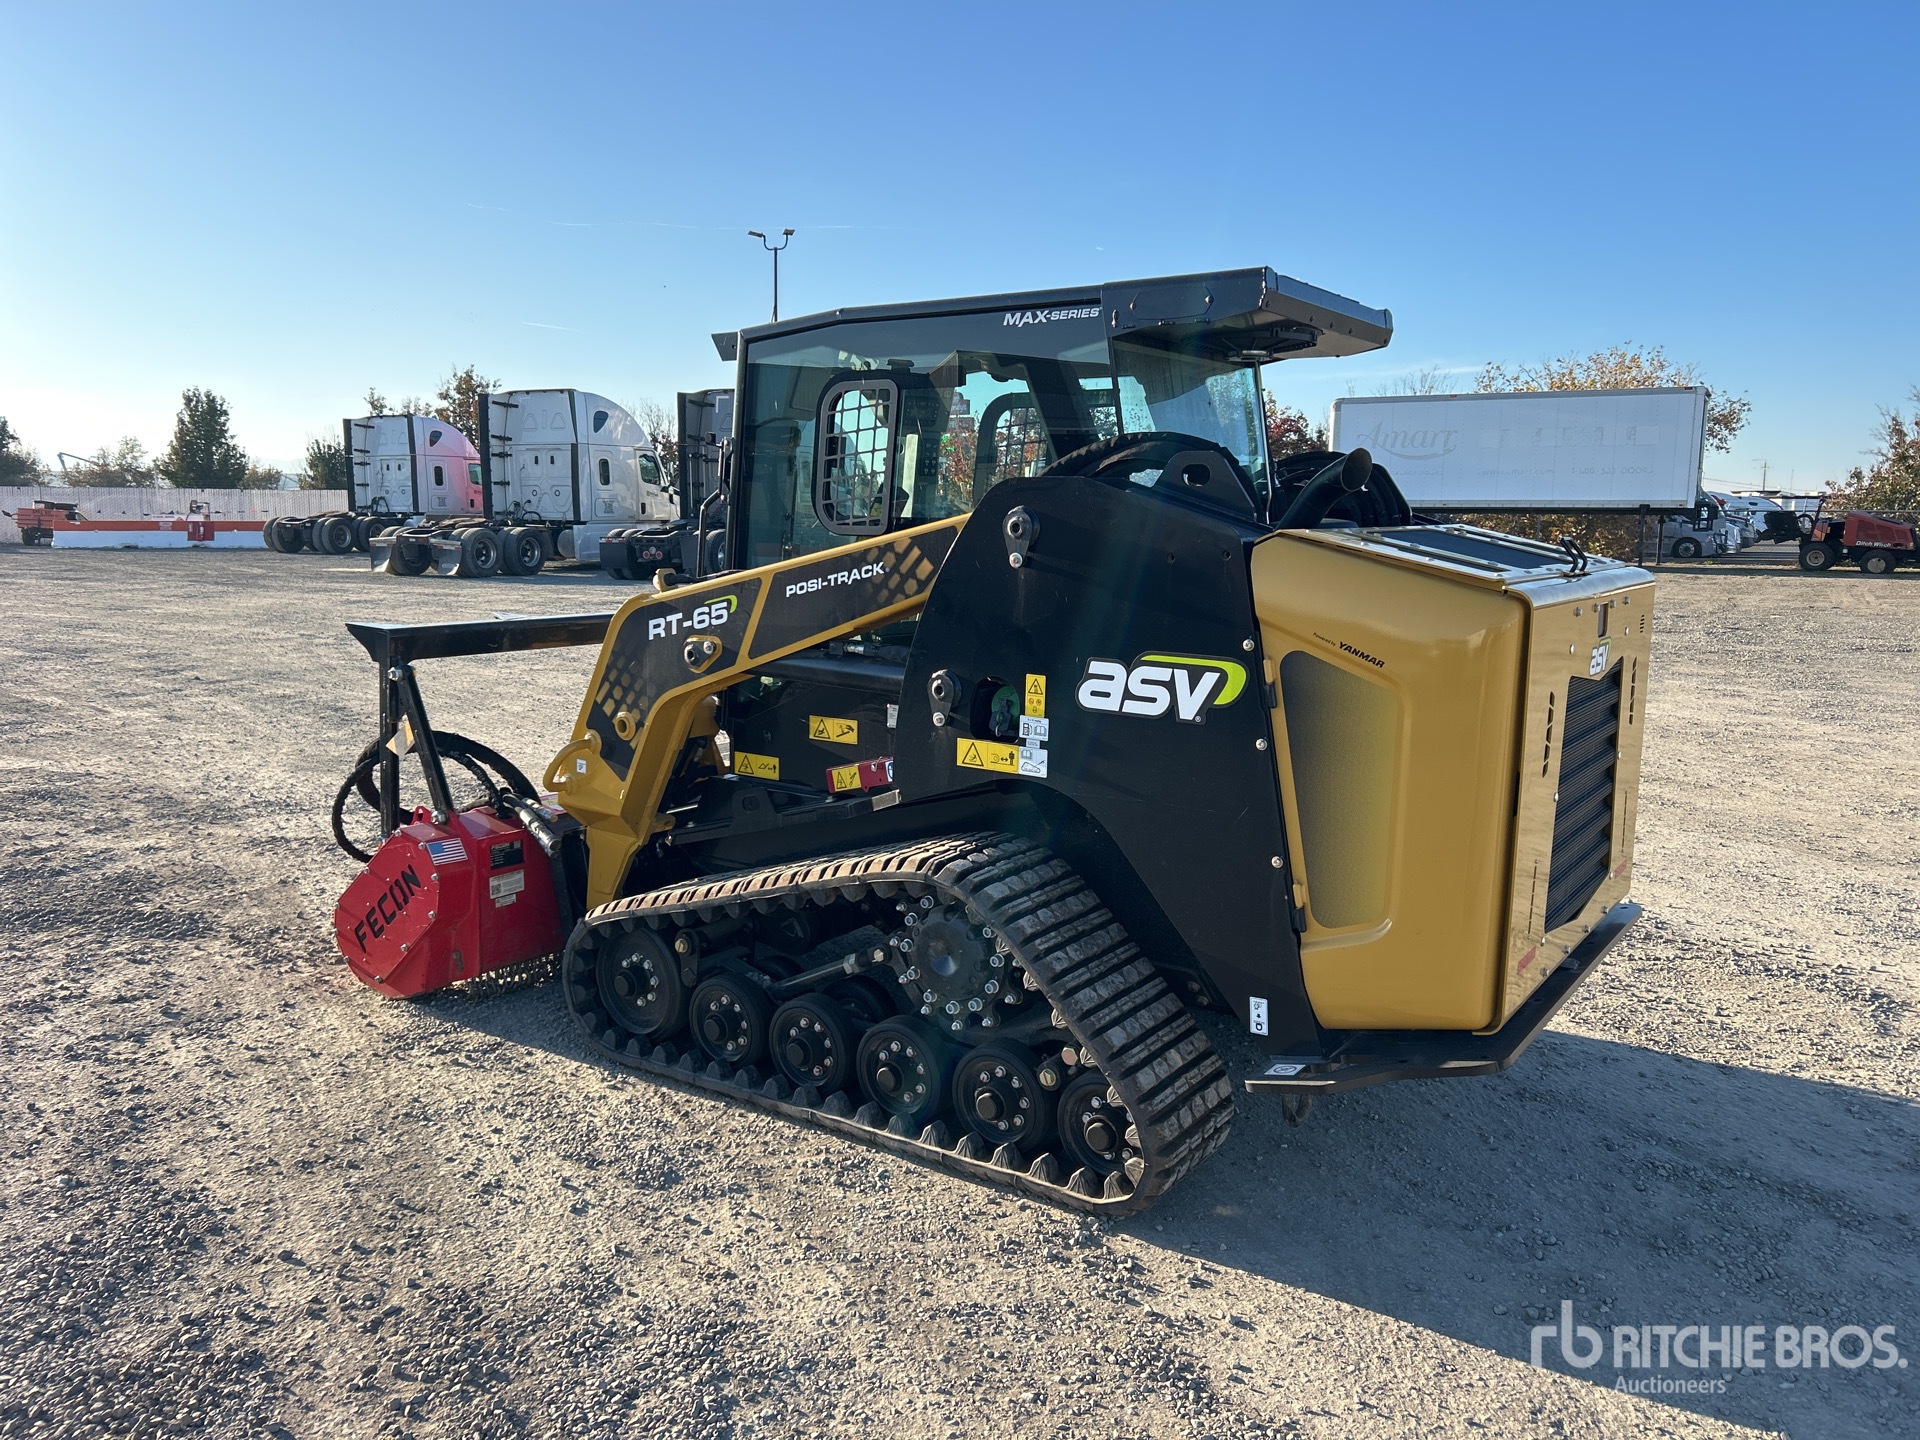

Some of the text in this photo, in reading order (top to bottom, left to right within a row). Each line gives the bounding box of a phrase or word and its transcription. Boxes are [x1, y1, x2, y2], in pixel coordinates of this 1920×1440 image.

[1003, 307, 1100, 327] MAX-SERIES
[1356, 420, 1459, 457] Amarr
[785, 562, 884, 597] POSI-TRACK
[648, 601, 728, 640] RT-65
[1312, 631, 1331, 645] Powered
[1339, 641, 1385, 668] YANMAR
[354, 864, 421, 953] FECON
